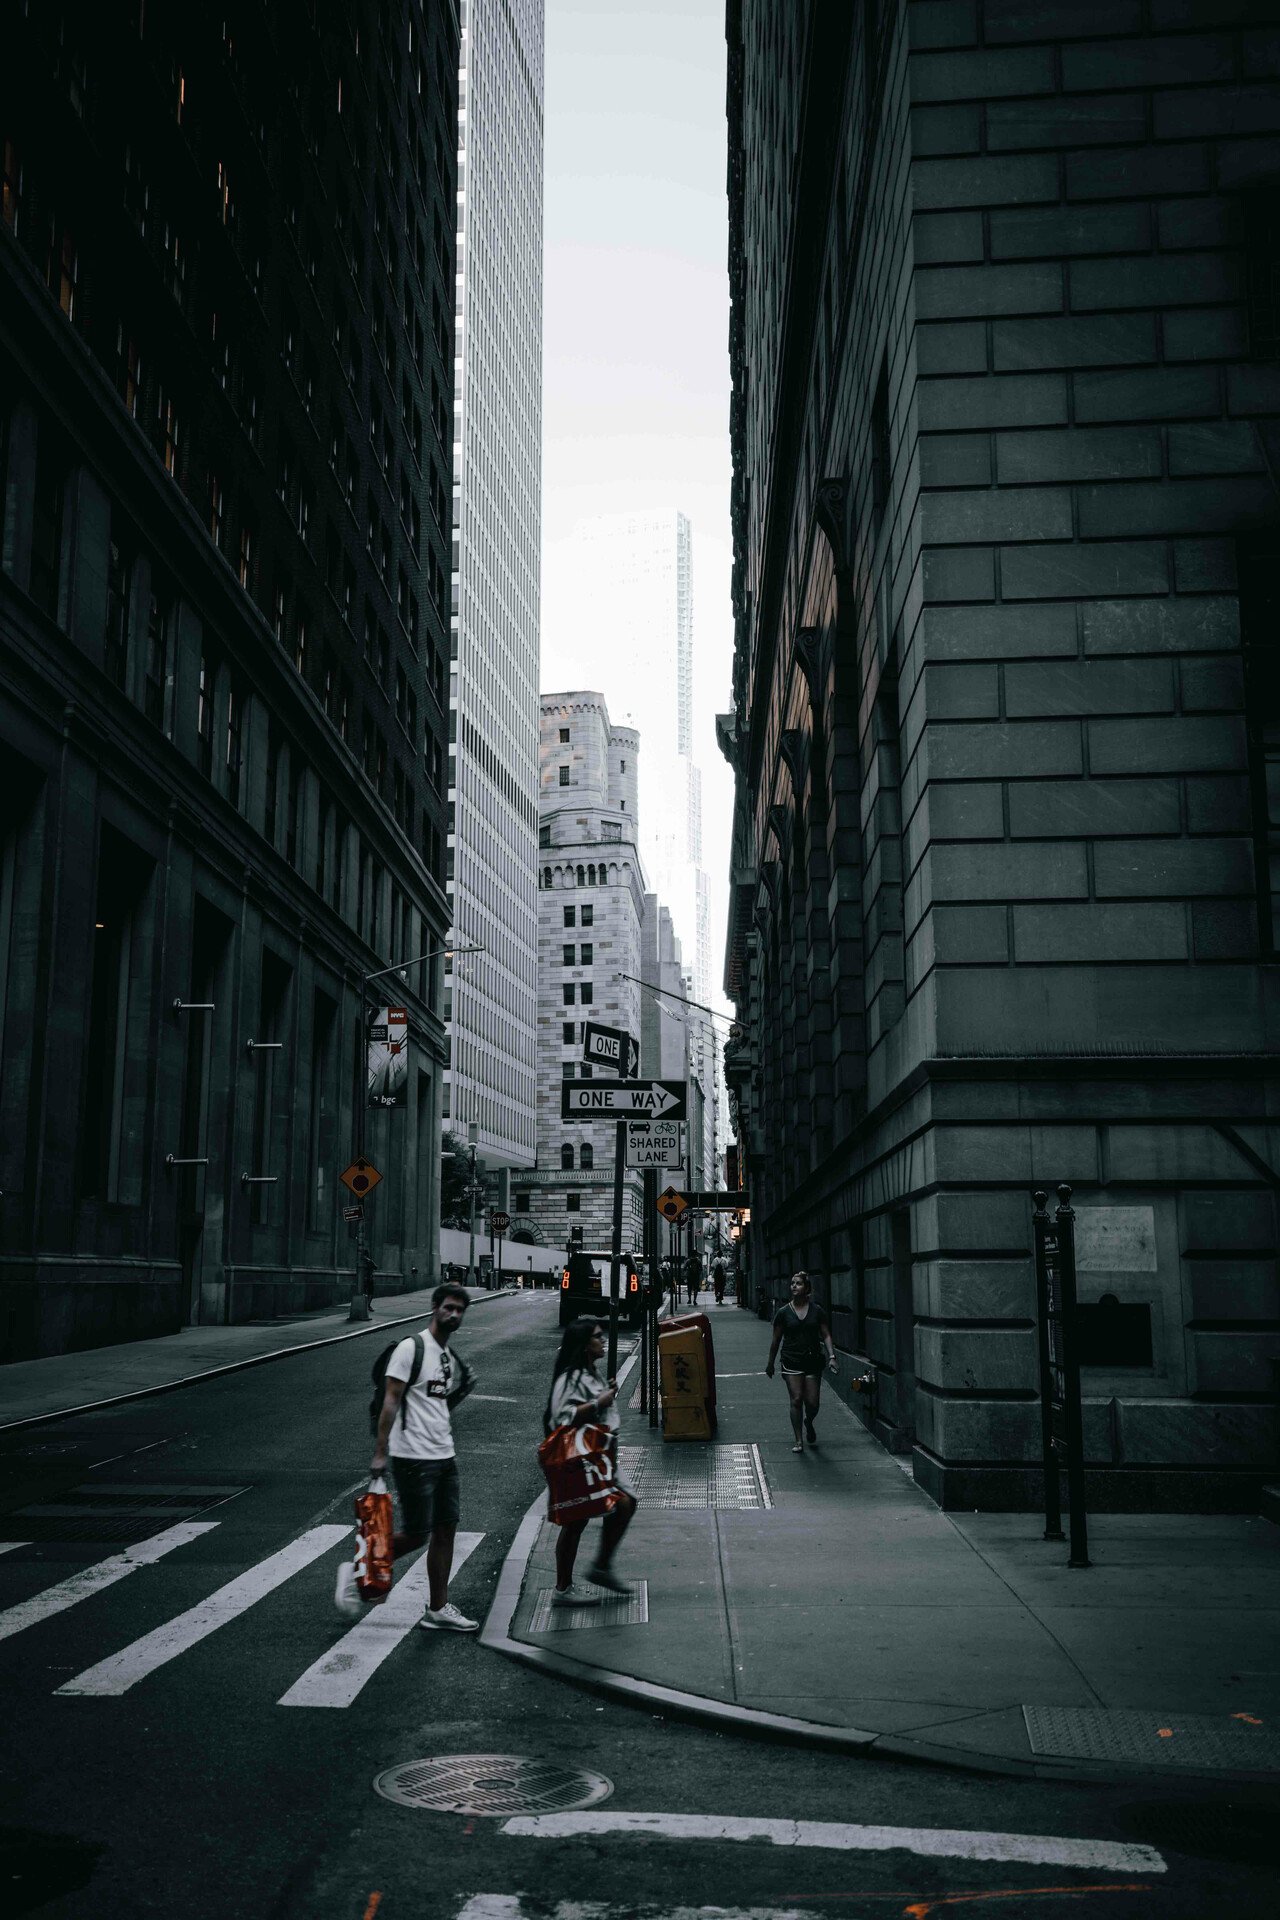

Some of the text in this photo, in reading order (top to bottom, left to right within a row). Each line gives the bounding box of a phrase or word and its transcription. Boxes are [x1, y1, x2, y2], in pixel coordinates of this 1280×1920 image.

[596, 1037, 619, 1057] ONE
[381, 1095, 396, 1106] bgc
[579, 1091, 668, 1108] ONE WAY
[630, 1137, 676, 1149] SHARED
[637, 1151, 668, 1162] LANE
[492, 1217, 509, 1225] STOP
